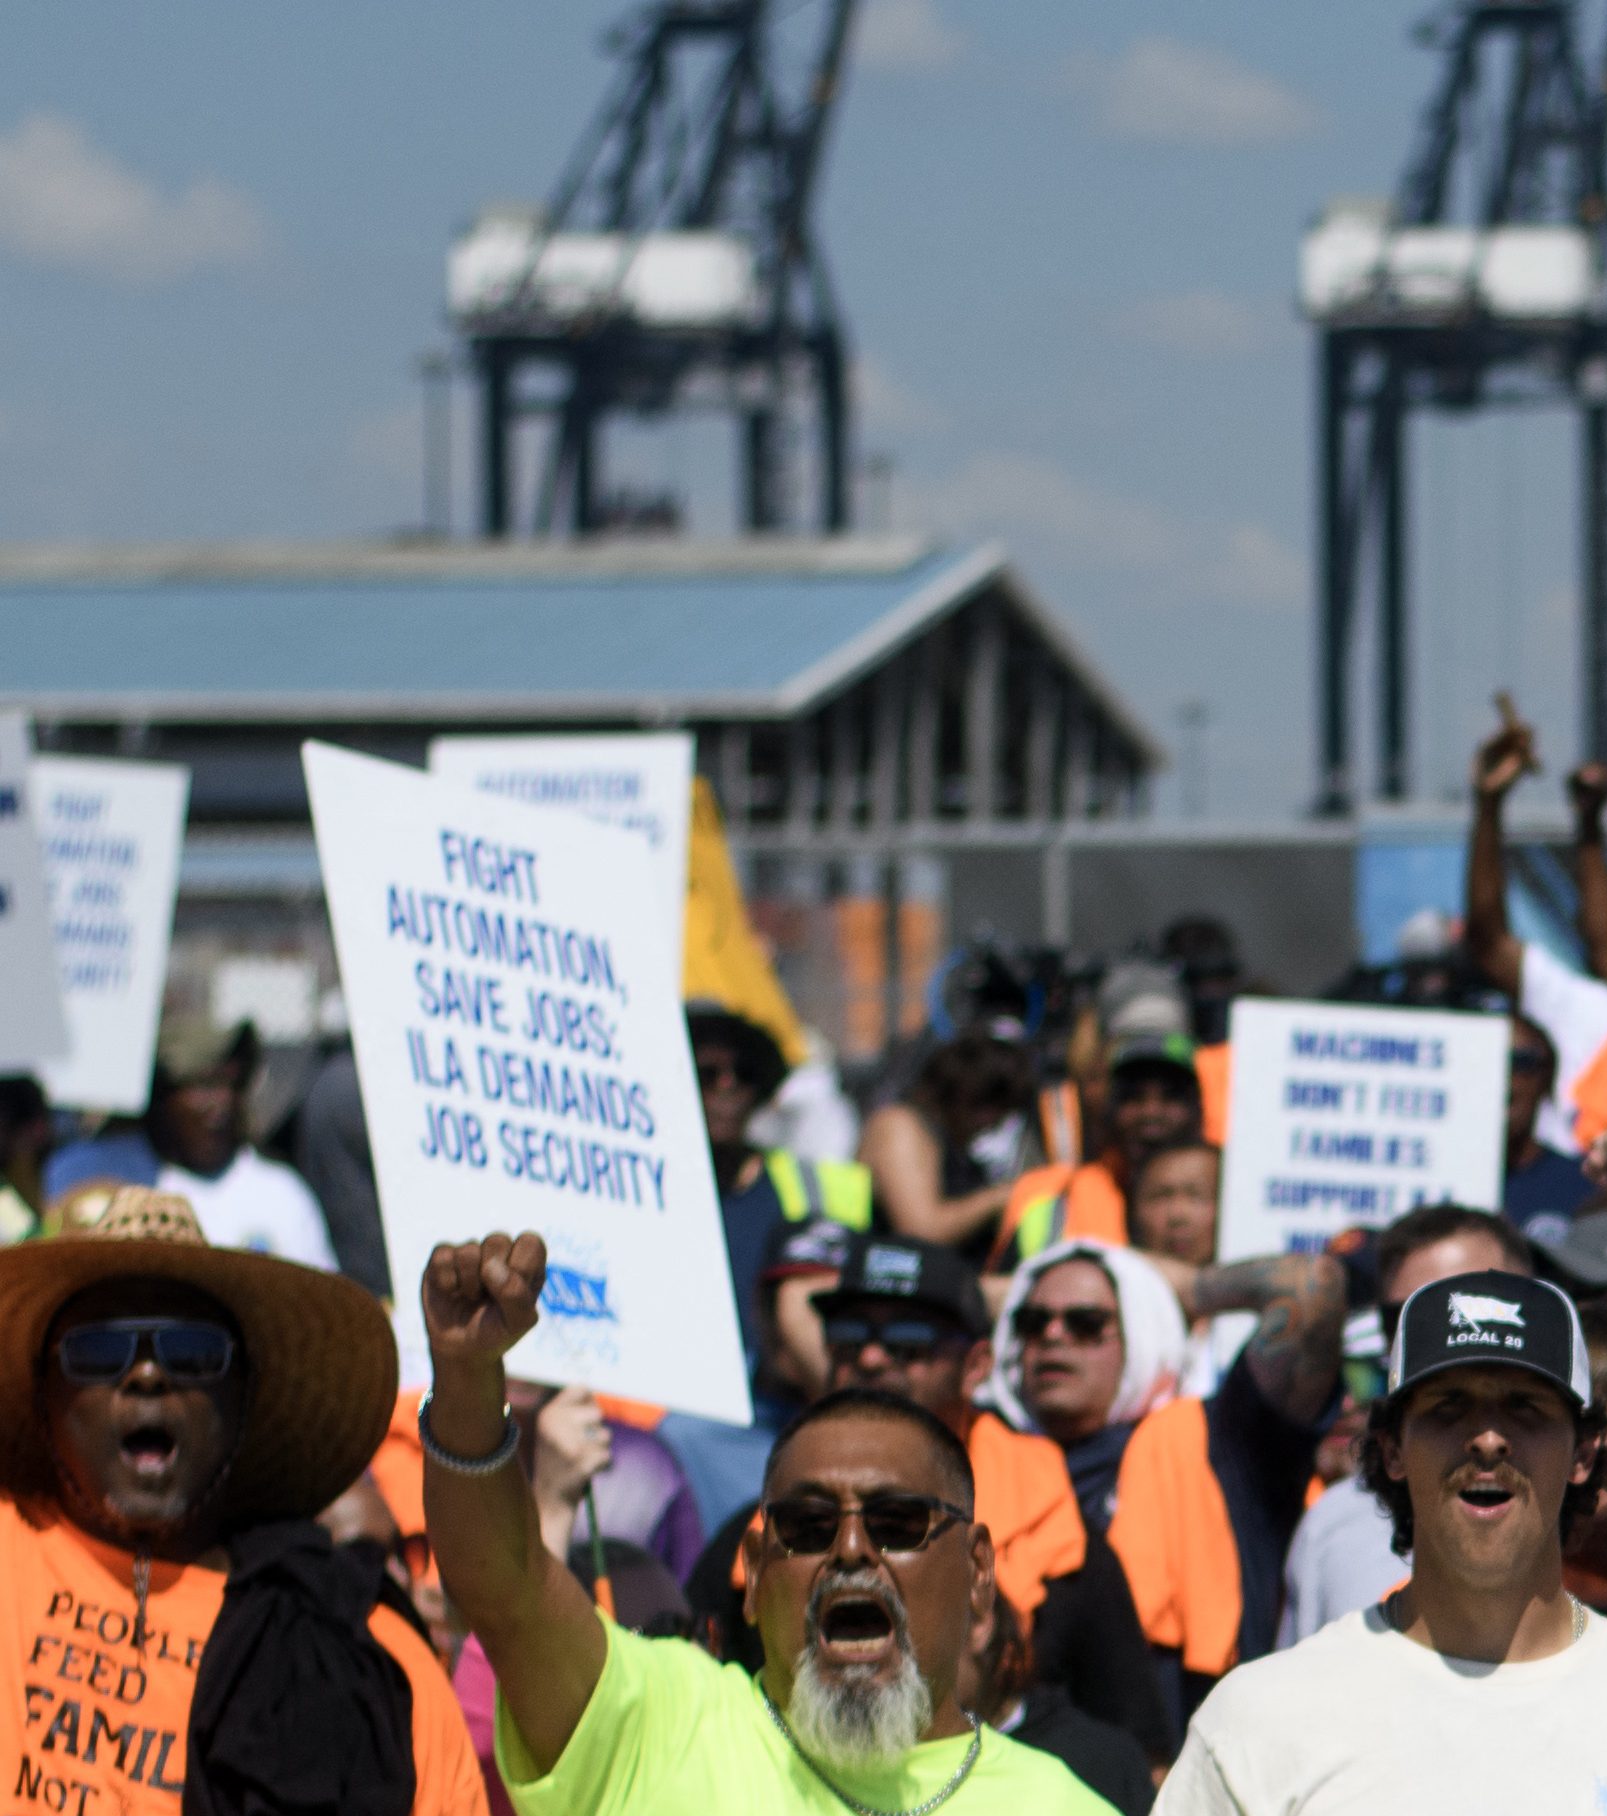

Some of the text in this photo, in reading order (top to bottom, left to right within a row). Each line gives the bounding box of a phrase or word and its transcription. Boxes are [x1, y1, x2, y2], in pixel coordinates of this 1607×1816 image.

[440, 829, 538, 902] FIGHT
[387, 887, 627, 1006] AUTOMATION,
[414, 961, 622, 1062] SAVE JOBS:
[408, 1030, 655, 1139] ILA DEMANDS
[421, 1103, 667, 1210] JOB SECURITY
[1447, 1332, 1500, 1347] LOCAL
[29, 1634, 147, 1705] FEED
[24, 1682, 186, 1794] FAMIL
